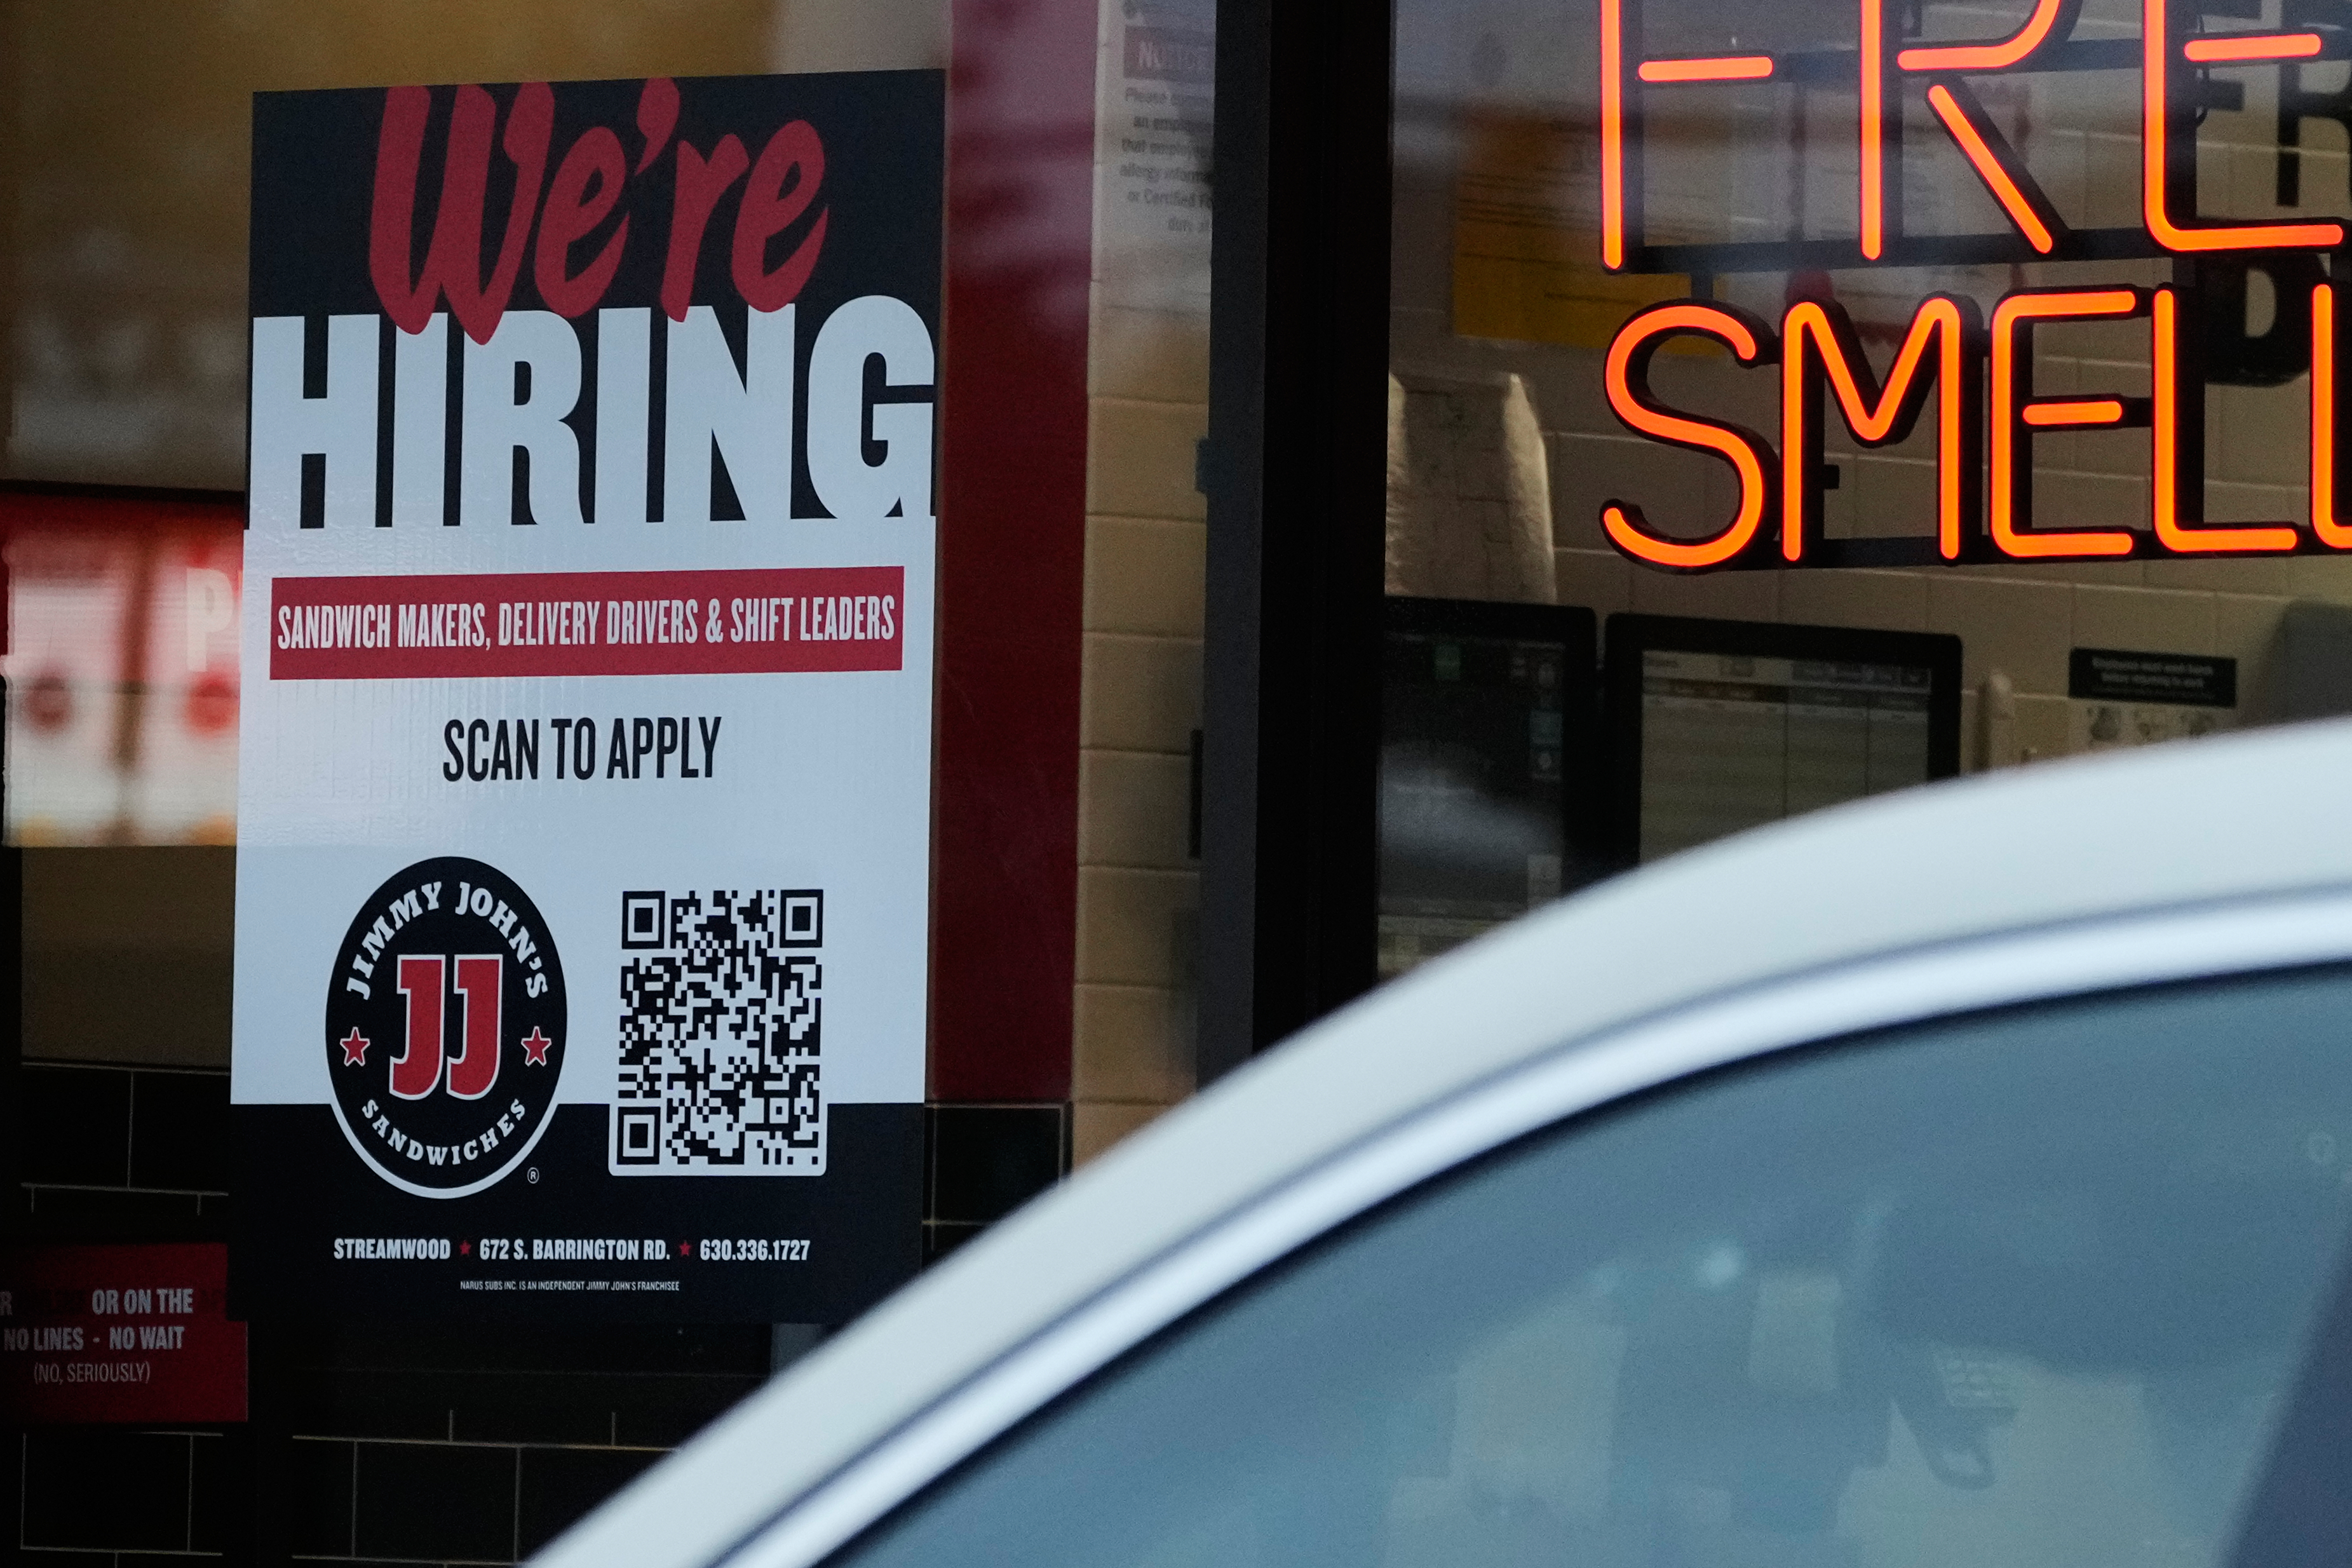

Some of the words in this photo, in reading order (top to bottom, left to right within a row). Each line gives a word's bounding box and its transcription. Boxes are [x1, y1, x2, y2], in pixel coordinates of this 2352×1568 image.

[369, 76, 828, 345] We're
[249, 295, 935, 529] HIRING
[278, 604, 391, 649] SANDWICH
[398, 602, 491, 651] MAKERS,
[498, 601, 600, 646] DELIVERY
[606, 598, 698, 644] DRIVERS
[705, 598, 724, 644] &
[730, 597, 794, 643] SHIFT
[800, 595, 895, 641] LEADERS
[443, 719, 539, 782] SCAN
[551, 717, 596, 780] TO
[607, 716, 722, 779] APPLY
[346, 881, 442, 1000] JIMMY
[455, 881, 548, 998] JOHN'S
[389, 954, 503, 1100] JJ
[362, 1098, 525, 1166] SANDWICHES
[334, 1238, 451, 1260] STREAMWOOD
[480, 1238, 509, 1260] 672
[513, 1238, 529, 1260] S.
[532, 1238, 639, 1260] BARRINGTON
[643, 1239, 670, 1260] RD.
[700, 1239, 811, 1261] 630.336.1727
[92, 1289, 119, 1315] OR
[124, 1288, 151, 1315] ON
[156, 1288, 194, 1314] THE
[460, 1280, 483, 1290] NARUS
[485, 1281, 503, 1290] SUBS
[519, 1281, 526, 1290] IS
[527, 1281, 537, 1290] AN
[538, 1281, 585, 1291] INDEPENDENT
[586, 1281, 610, 1291] JIMMY
[638, 1281, 680, 1292] FRANCHISEE
[4, 1328, 29, 1351] NO
[34, 1327, 84, 1351] LINES
[109, 1327, 135, 1350] NO
[139, 1326, 185, 1350] WAIT
[34, 1363, 63, 1385] (NO,
[67, 1361, 151, 1383] SERIOUSLY)
